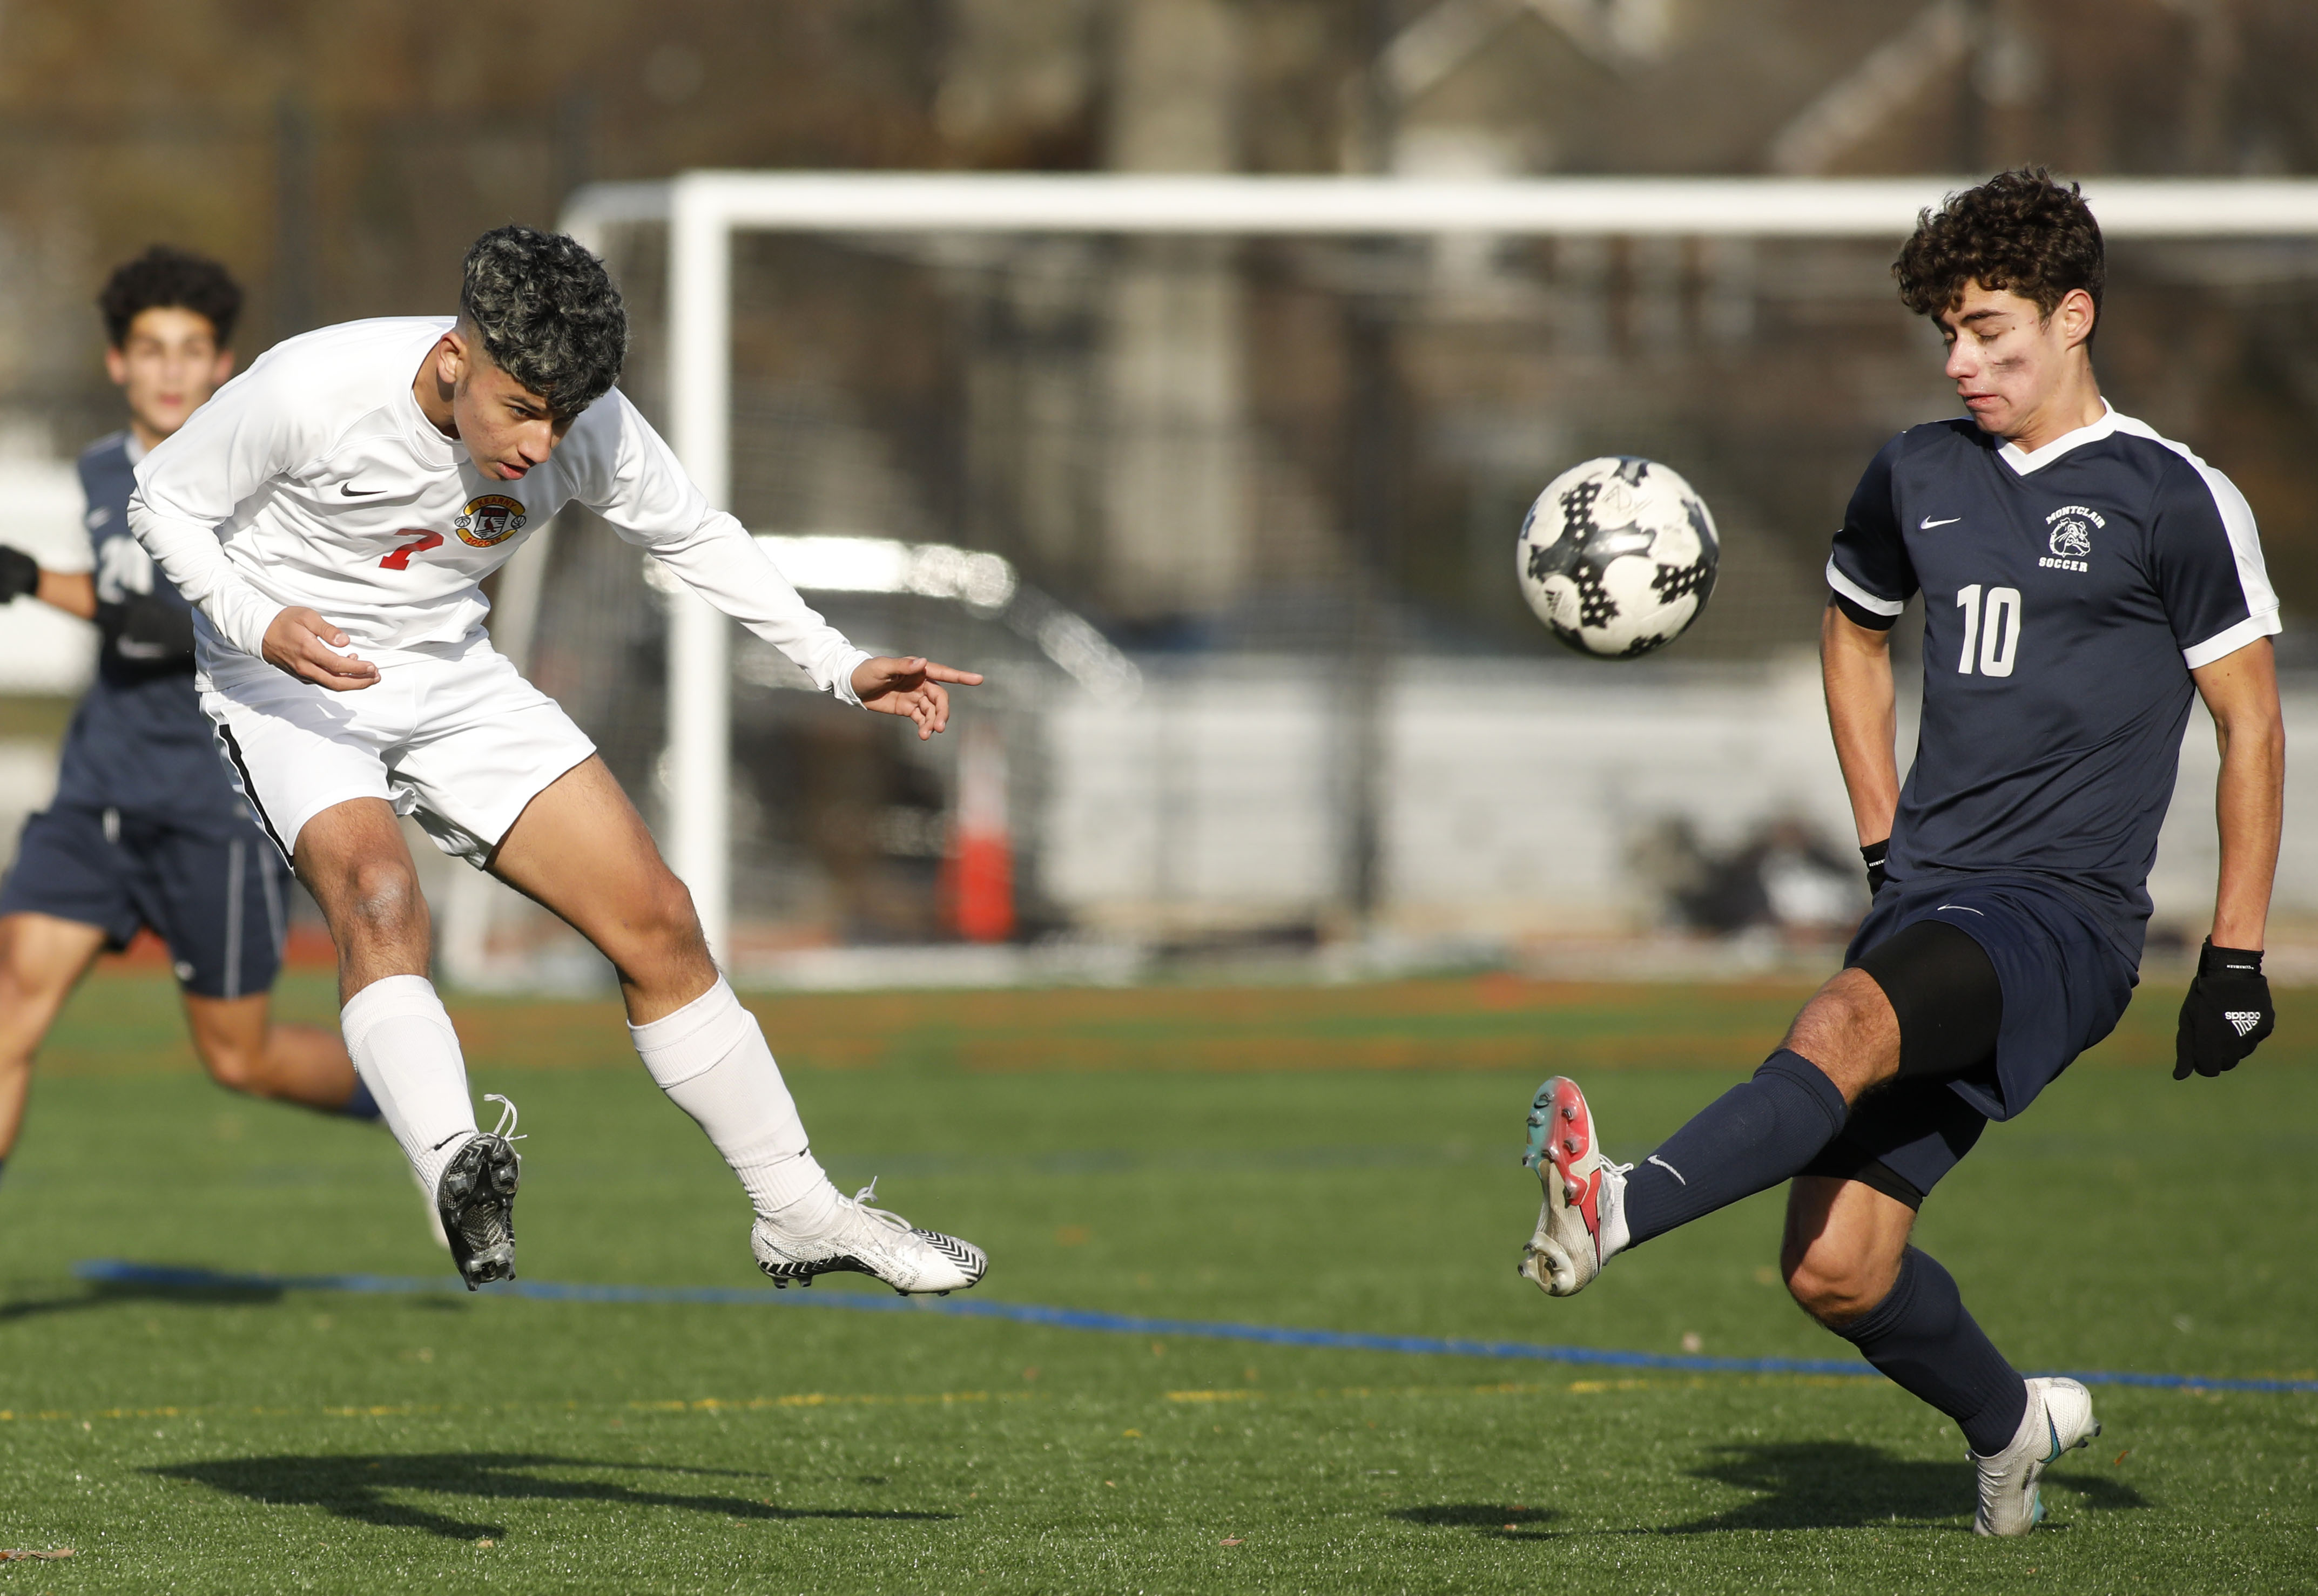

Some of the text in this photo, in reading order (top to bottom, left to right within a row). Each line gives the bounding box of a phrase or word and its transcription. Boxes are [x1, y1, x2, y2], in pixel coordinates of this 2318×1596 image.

[477, 497, 517, 507] KEARNY
[2045, 505, 2105, 529] MONTCLAIR
[465, 537, 502, 546] SOCCER
[2038, 557, 2088, 572] SOCCER
[1957, 584, 2021, 678] 10
[2225, 1011, 2261, 1021] adidas
